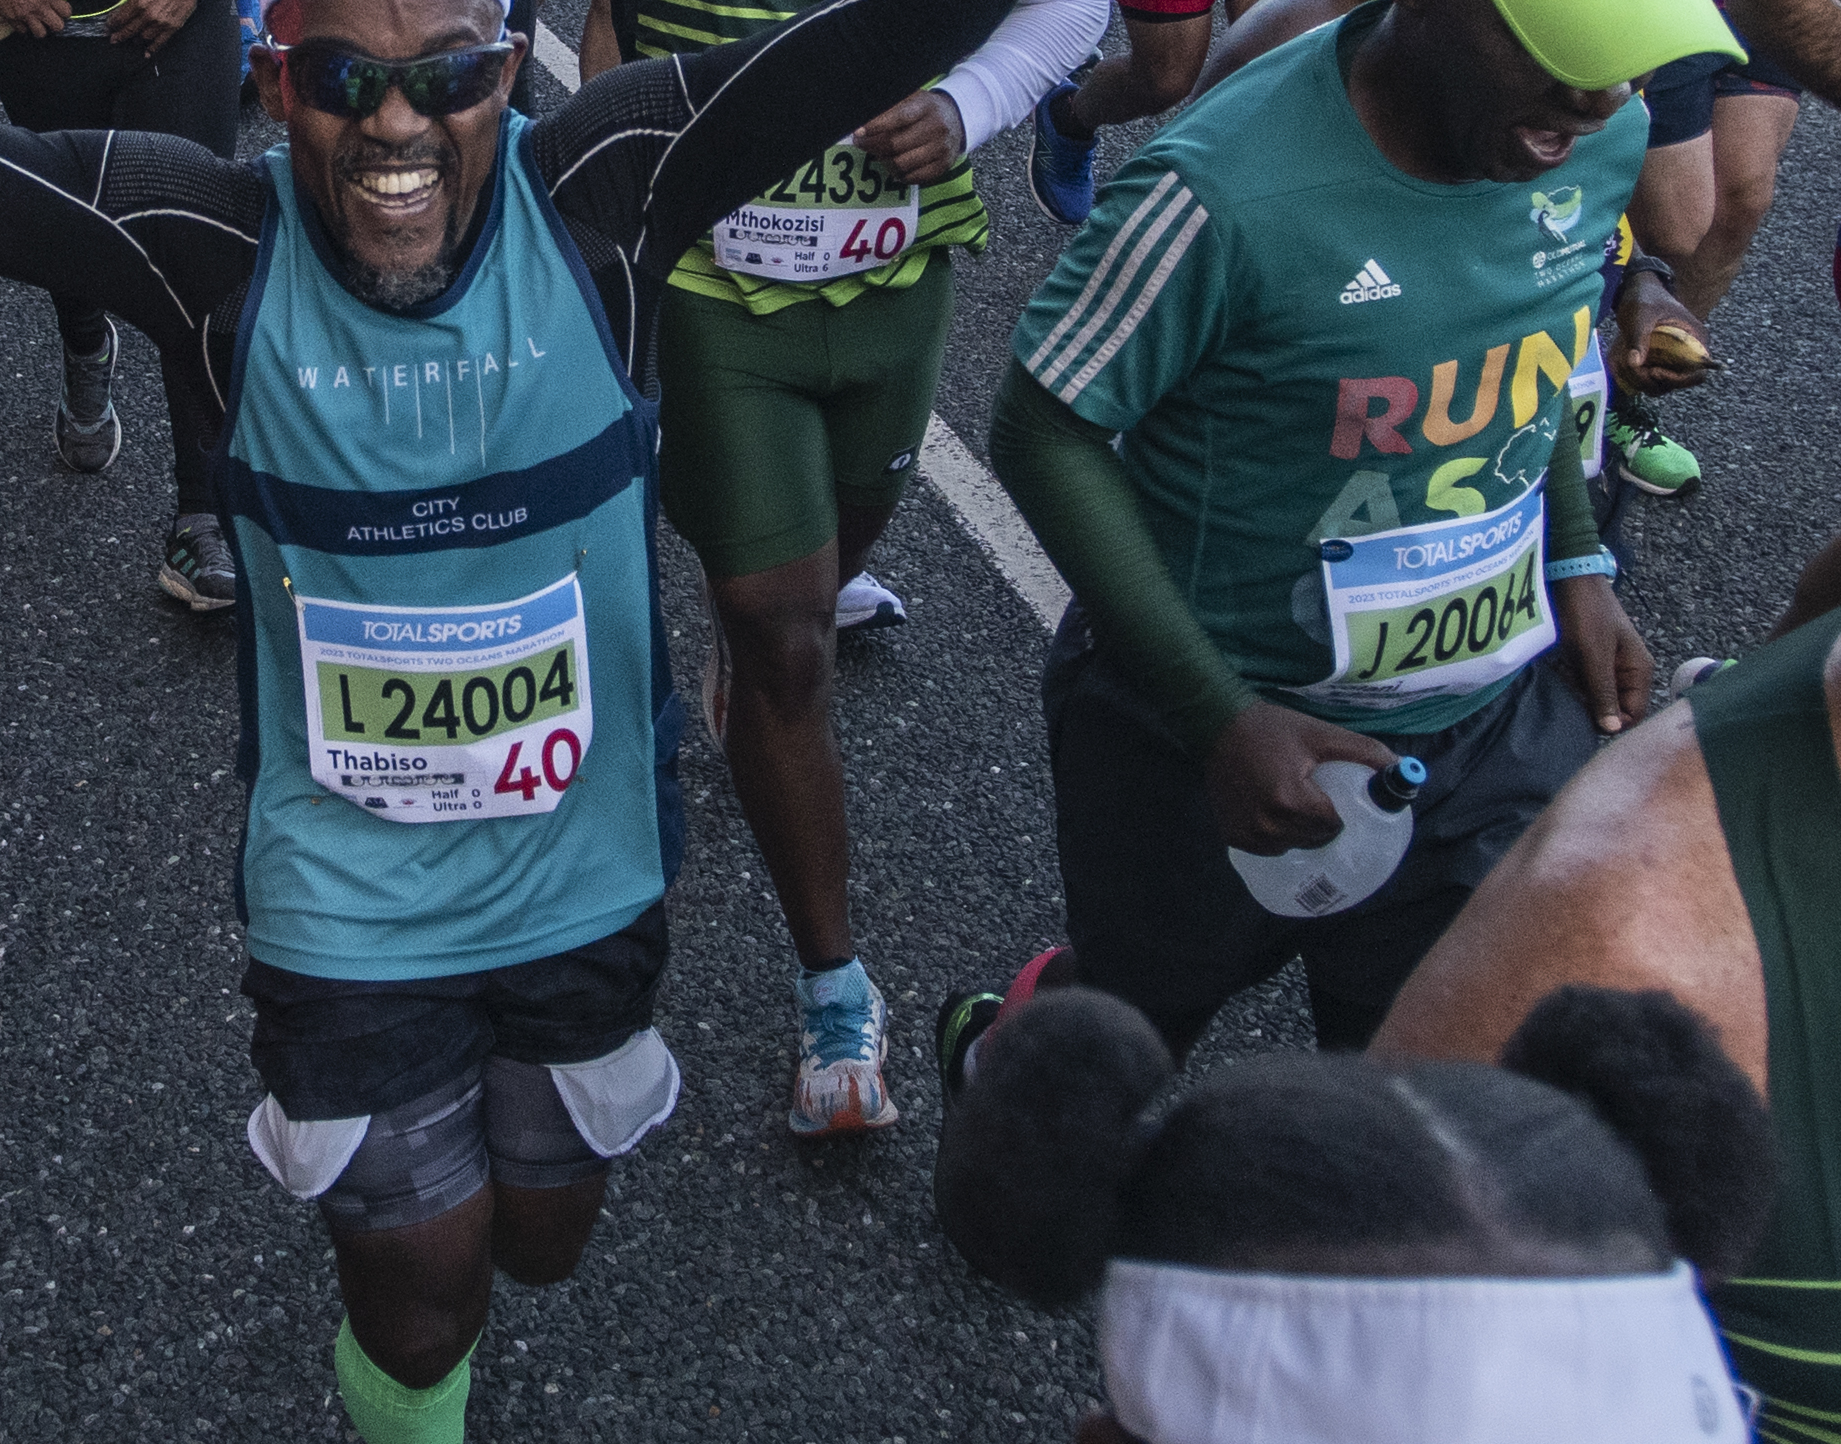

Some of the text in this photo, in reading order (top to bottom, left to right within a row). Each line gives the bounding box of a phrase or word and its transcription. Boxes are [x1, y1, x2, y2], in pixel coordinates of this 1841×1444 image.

[725, 211, 825, 232] Mthokozisi
[794, 251, 831, 261] Half 0
[839, 217, 907, 264] 40
[794, 264, 829, 273] Ultra 6
[1340, 282, 1402, 306] adidas
[297, 337, 546, 389] WATERFALL
[1328, 305, 1592, 460] RUN
[1575, 400, 1596, 445] 9
[412, 497, 460, 517] CITY
[347, 507, 529, 541] ATHLETICS CLUB
[1394, 512, 1524, 571] TOTALSPORTS
[1348, 593, 1376, 604] 2023
[1378, 578, 1451, 599] TOTALSPORTS
[1453, 571, 1474, 584] TWO
[362, 614, 523, 644] TOTALSPORTS
[1358, 551, 1536, 680] J 20064
[319, 629, 566, 666] 2023 TOTALSPORTS TWO OCEANS MARATHON
[339, 648, 575, 740] L 24004
[326, 748, 428, 772] Thabiso
[493, 727, 582, 802] 40
[431, 788, 481, 799] Half 0
[433, 800, 483, 812] Ultra 0
